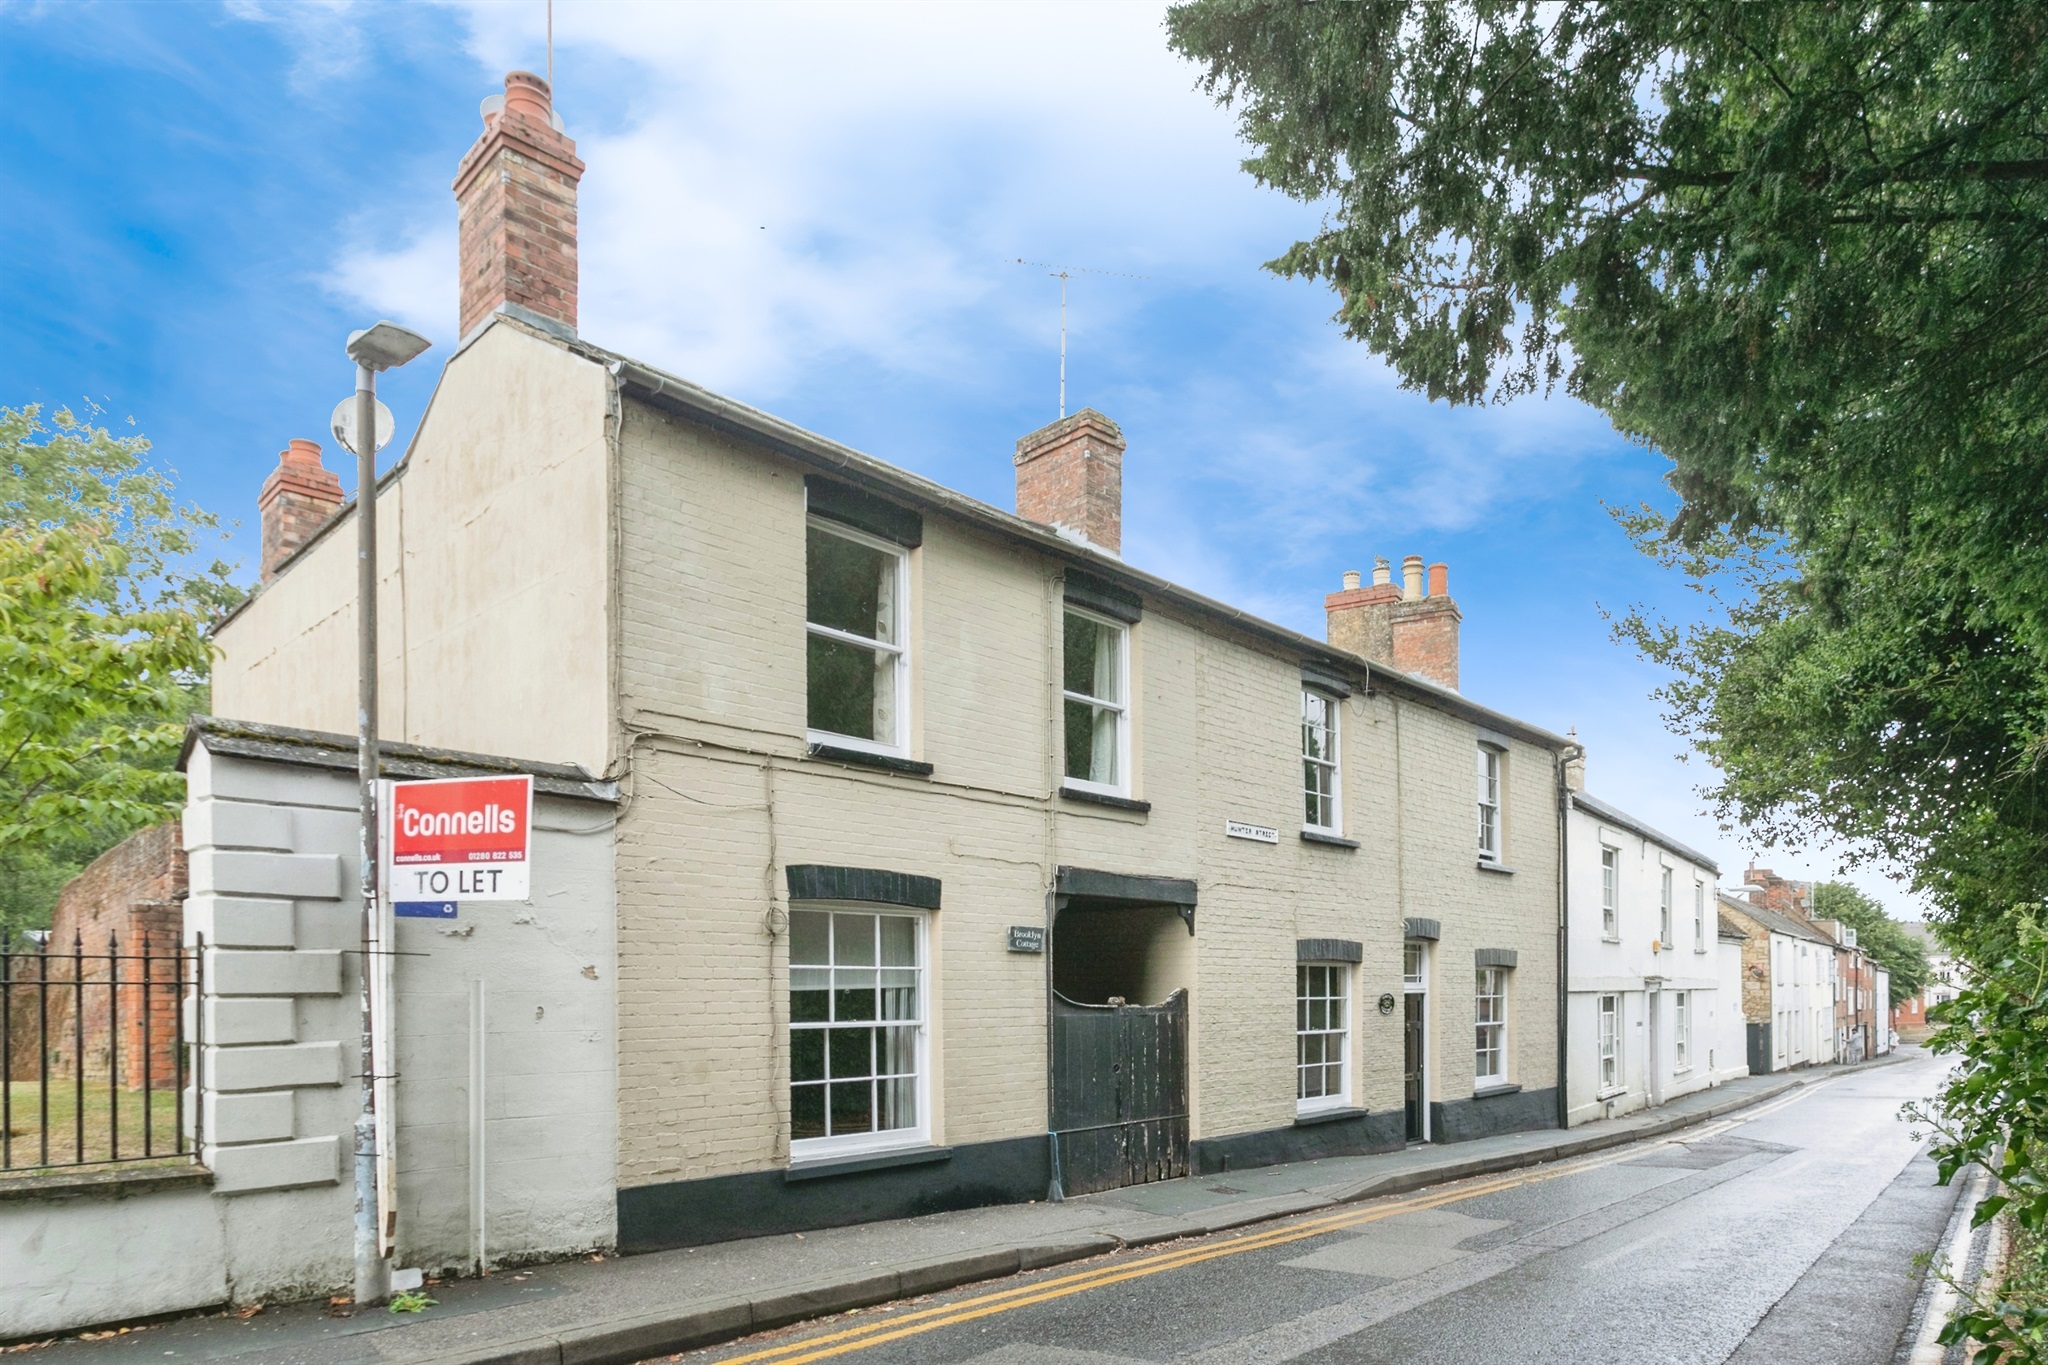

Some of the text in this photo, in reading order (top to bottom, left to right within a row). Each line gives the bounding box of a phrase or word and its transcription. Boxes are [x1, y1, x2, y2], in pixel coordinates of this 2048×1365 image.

[403, 804, 516, 837] Connells
[1230, 826, 1275, 838] HUNTER STREET
[395, 853, 441, 862] connells.co.uk
[508, 851, 522, 859] 535
[414, 869, 503, 894] TO LET
[1014, 930, 1041, 940] Brooklyn
[1016, 939, 1039, 950] Cottage
